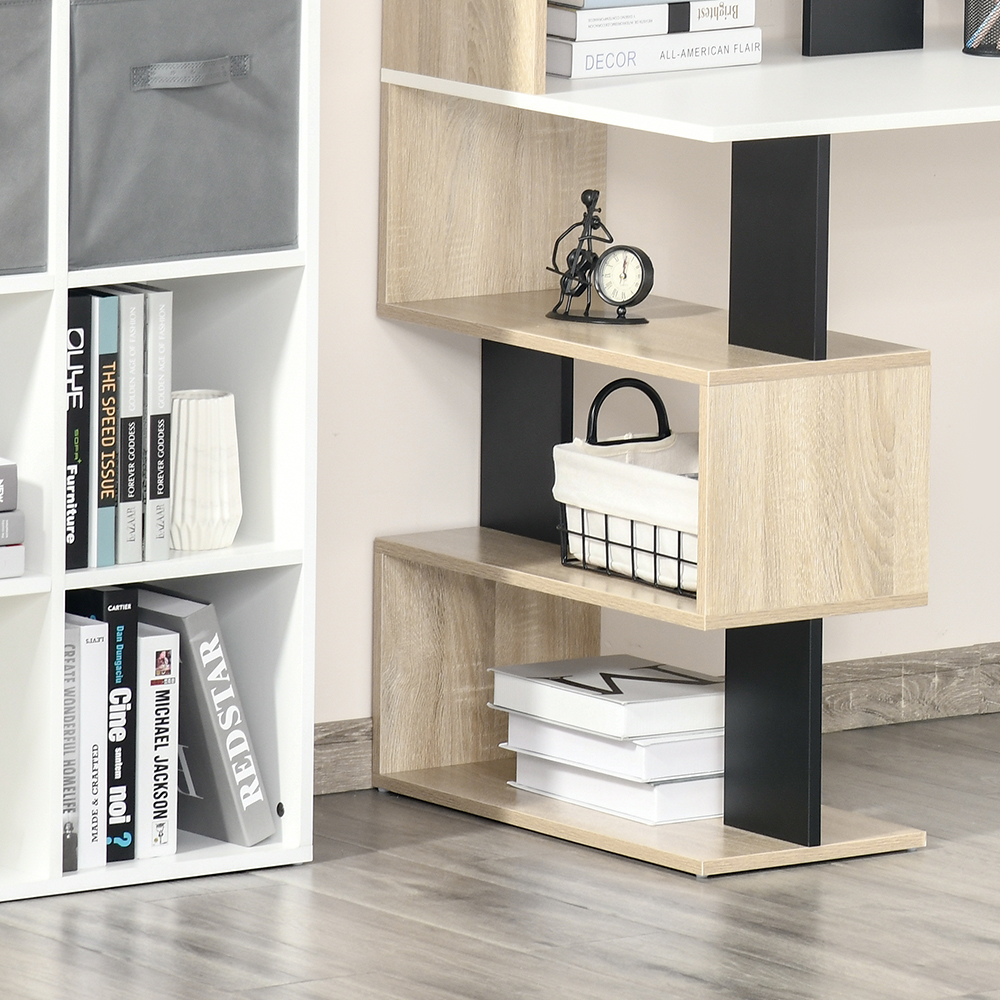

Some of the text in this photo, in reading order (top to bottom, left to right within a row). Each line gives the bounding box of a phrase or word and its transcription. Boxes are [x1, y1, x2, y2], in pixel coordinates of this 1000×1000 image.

[697, 2, 739, 21] Brightest
[585, 51, 637, 71] DECOR
[659, 41, 761, 60] ALL-AMERICAN FLAIR
[129, 306, 137, 343] FASHION
[129, 345, 136, 357] OF
[158, 304, 166, 409] GOLDEN AGE OF FASHION
[128, 376, 136, 412] GOLDEN
[100, 361, 117, 500] THE SPEED ISSUE
[128, 421, 136, 498] FOREVER GODDESS
[157, 419, 165, 495] FOREVER GODDESS
[66, 464, 78, 545] Furniture
[107, 603, 132, 612] CARTIER
[113, 625, 125, 684] Dan Dungaciu
[63, 643, 76, 814] CREATE WONDERFUL HOMELIFE
[108, 687, 132, 743] Cine
[154, 689, 170, 752] MICHAEL
[91, 744, 100, 843] MADE & CRAFTED
[109, 786, 132, 826] noi
[152, 756, 170, 820] JACKSON
